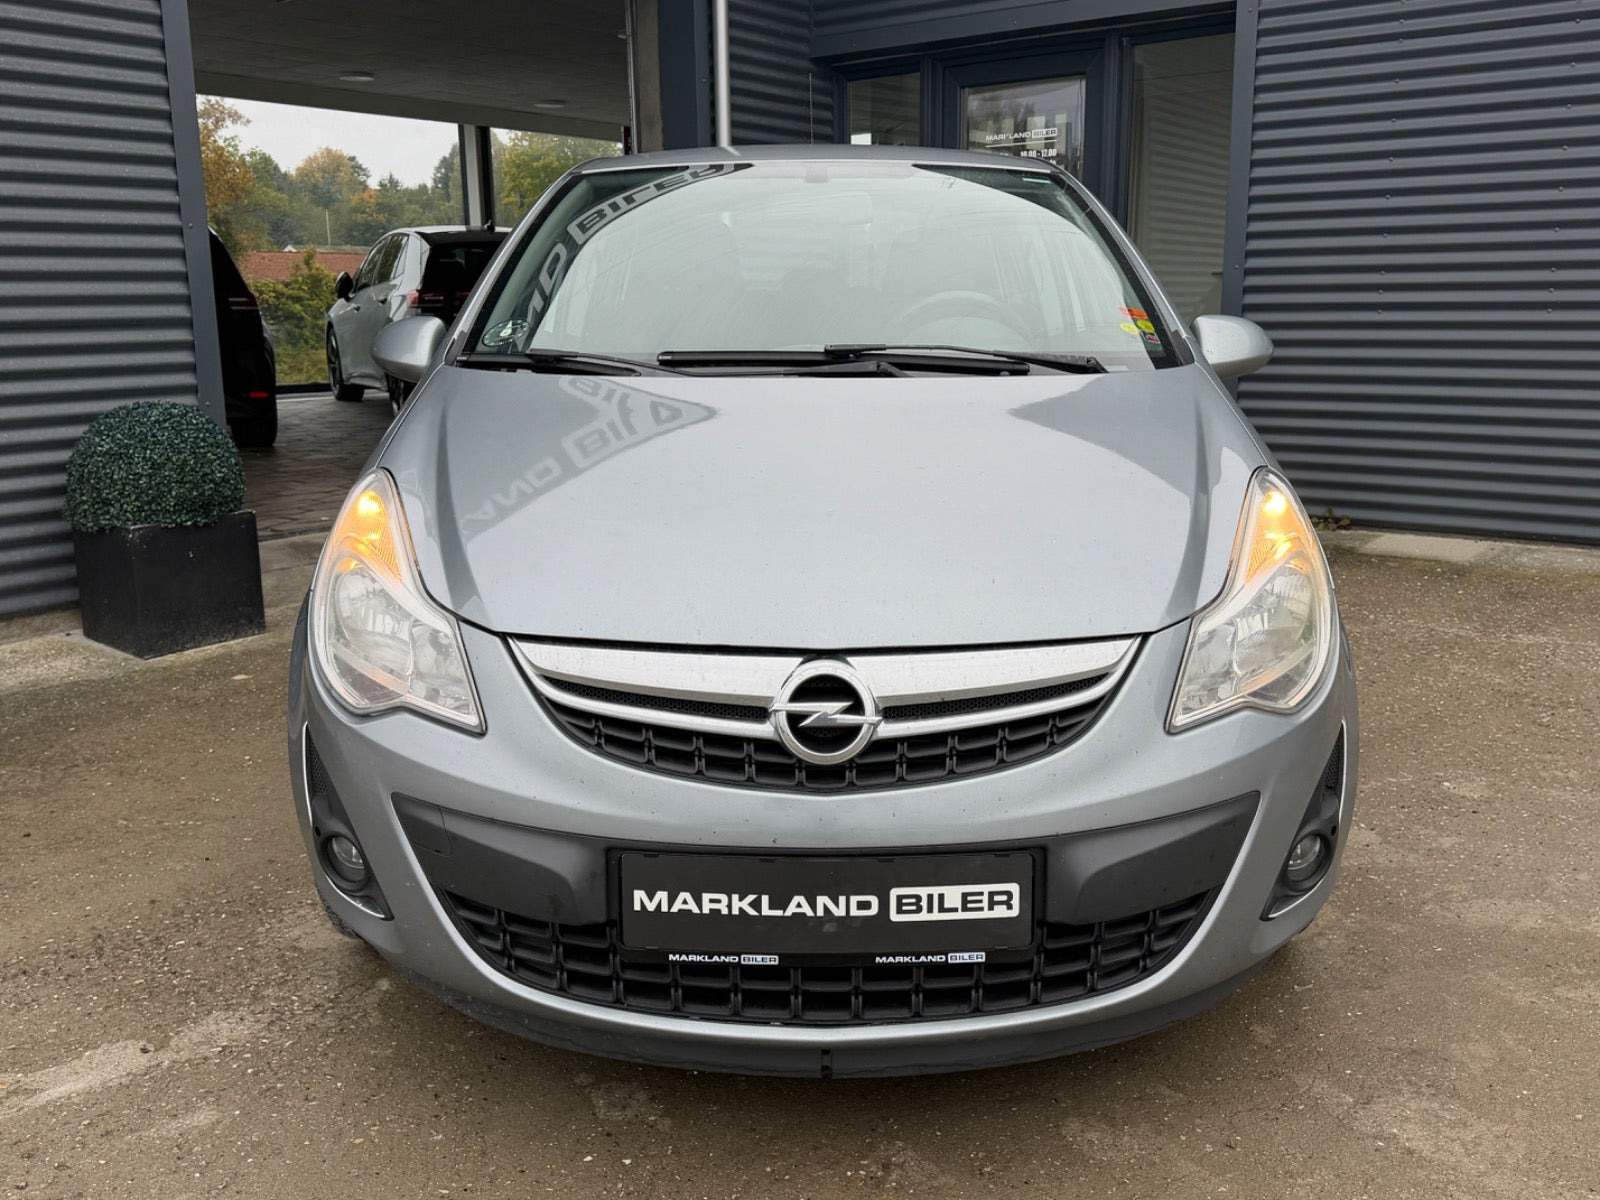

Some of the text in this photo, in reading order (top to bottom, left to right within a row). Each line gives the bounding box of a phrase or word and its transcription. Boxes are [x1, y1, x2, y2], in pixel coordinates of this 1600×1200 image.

[633, 889, 1014, 917] MARKLAND BILER
[668, 953, 777, 964] MARKLAND BILER
[875, 953, 984, 964] MARKLAND BILER
